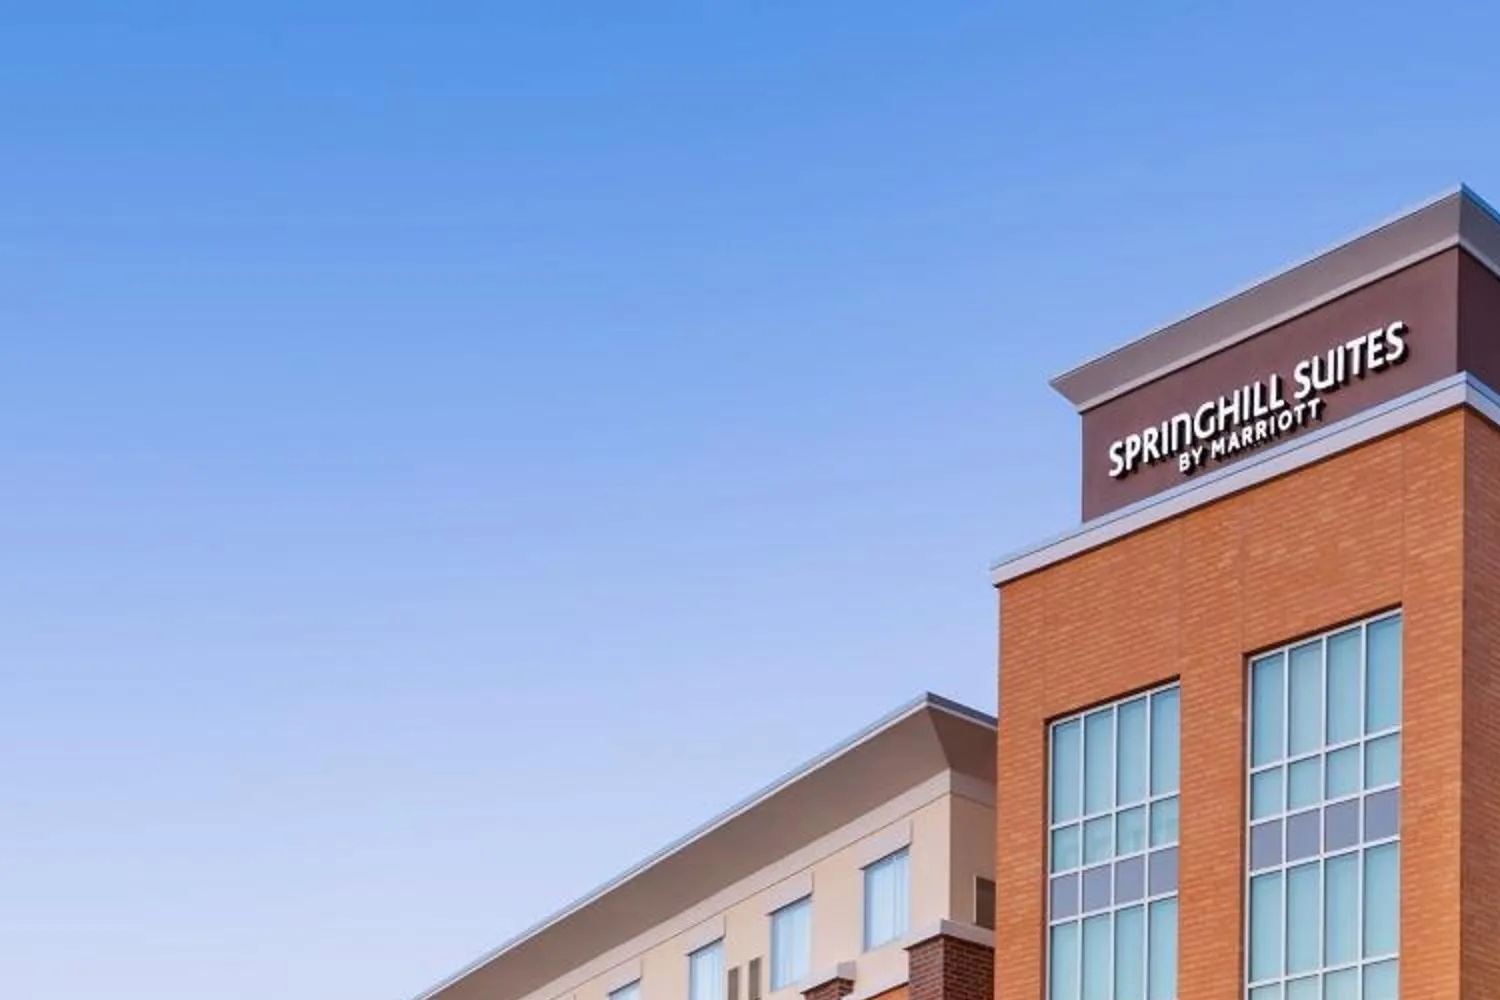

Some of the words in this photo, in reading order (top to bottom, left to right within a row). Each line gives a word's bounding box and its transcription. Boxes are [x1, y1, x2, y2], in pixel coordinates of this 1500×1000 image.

[1108, 373, 1285, 477] SPRINGHILL
[1293, 320, 1404, 399] SUITES
[1178, 447, 1203, 473] BY
[1210, 397, 1322, 460] MARRIOTT
